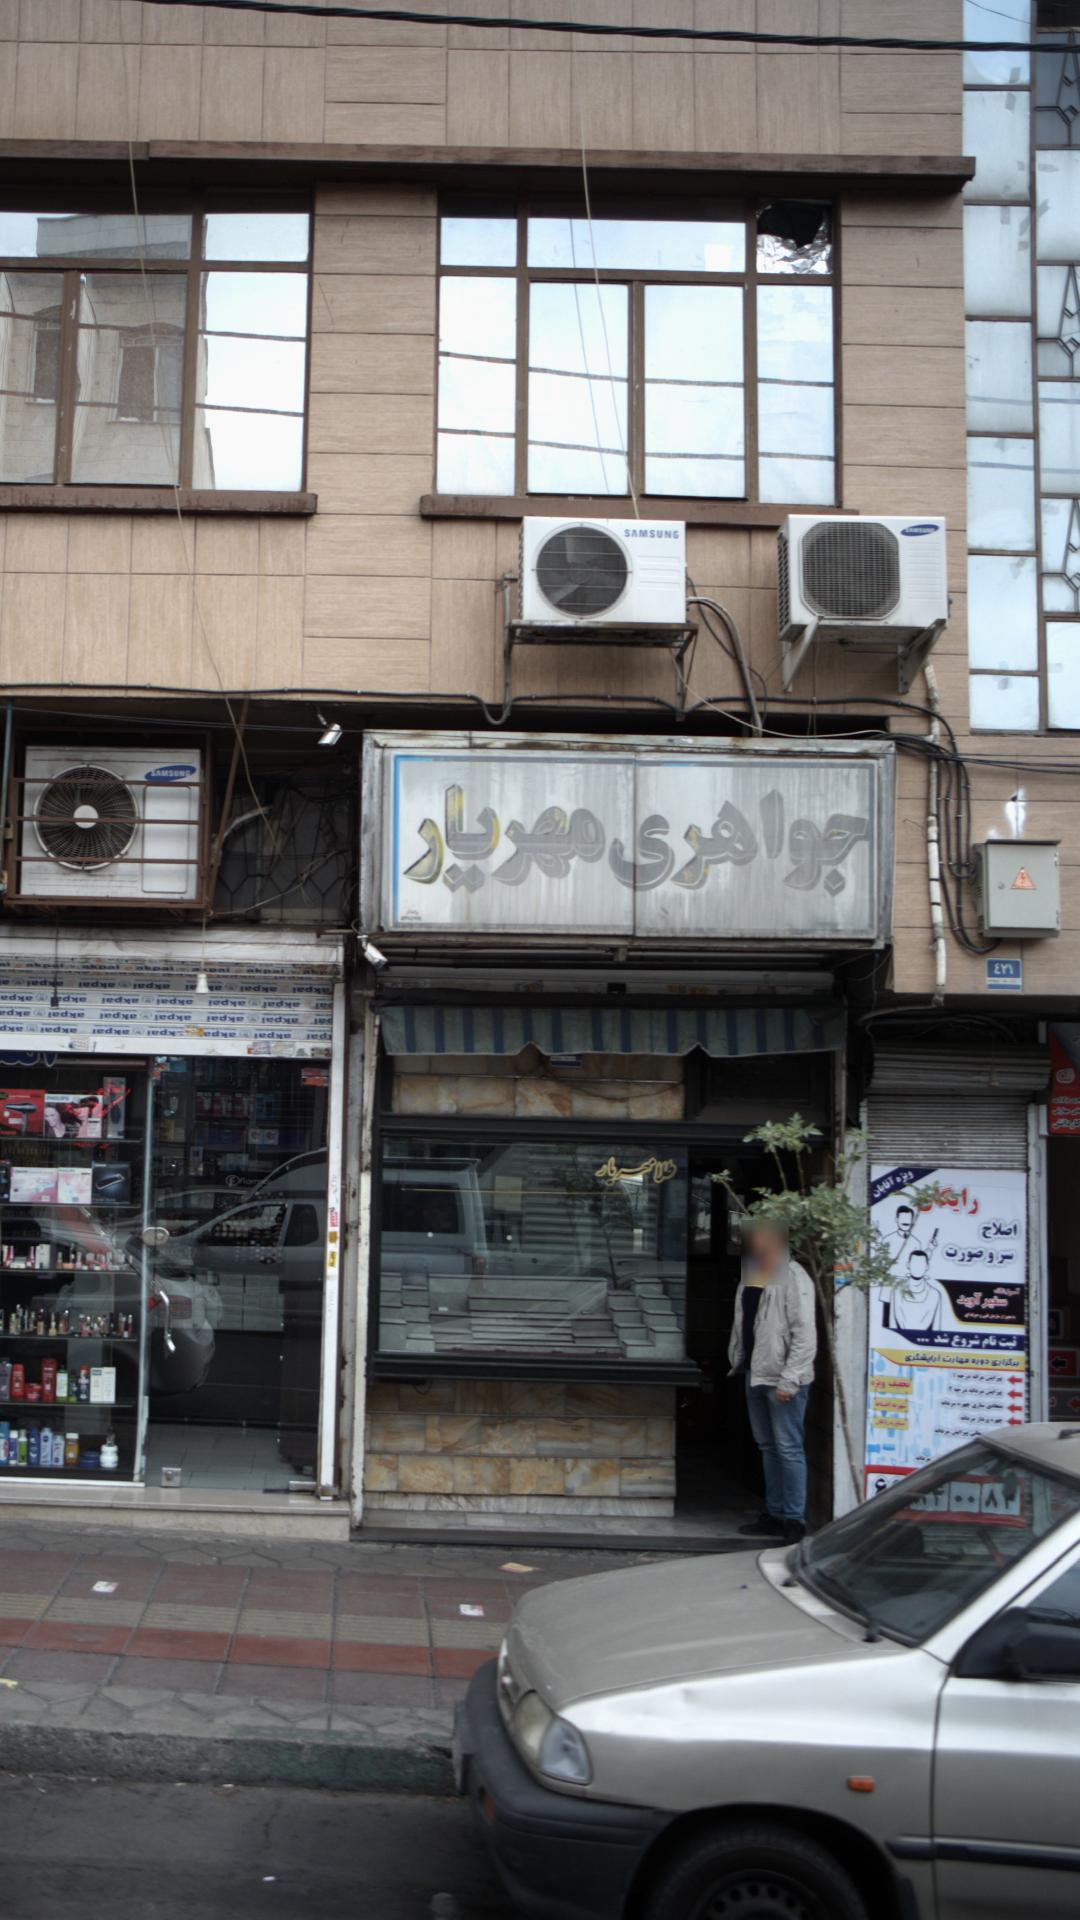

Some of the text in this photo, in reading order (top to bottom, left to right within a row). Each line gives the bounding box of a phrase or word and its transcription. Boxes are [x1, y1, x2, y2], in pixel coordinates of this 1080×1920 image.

[624, 529, 679, 539] SAMSUNG
[150, 768, 191, 777] SAMSUNG
[402, 783, 868, 897] جواهری مهریار
[27, 979, 64, 987] akpai
[79, 980, 116, 988] akpai
[133, 982, 170, 990] akpai
[240, 984, 278, 992] akpai
[293, 985, 331, 993] akpai
[102, 995, 139, 1004] akpai
[156, 997, 193, 1005] akpai
[208, 999, 246, 1007] akpai
[263, 1000, 300, 1009] akpai
[48, 1010, 85, 1019] akpai
[100, 1012, 137, 1020] akpai
[155, 1013, 192, 1021] akpai
[207, 1015, 244, 1023] akpai
[262, 1016, 299, 1024] akpai
[40, 1026, 78, 1034] akpai
[92, 1028, 130, 1036] akpai
[254, 1032, 291, 1040] akpai
[594, 1156, 658, 1187] مهریار
[872, 1171, 914, 1198] ویژه آقایان
[982, 1222, 1018, 1239] اصلاح
[945, 1247, 1014, 1264] سر و صورت
[934, 1333, 950, 1343] شد
[951, 1334, 980, 1348] شروع
[981, 1335, 998, 1348] نام
[998, 1335, 1018, 1349] ثبت
[942, 1355, 970, 1364] مهارت
